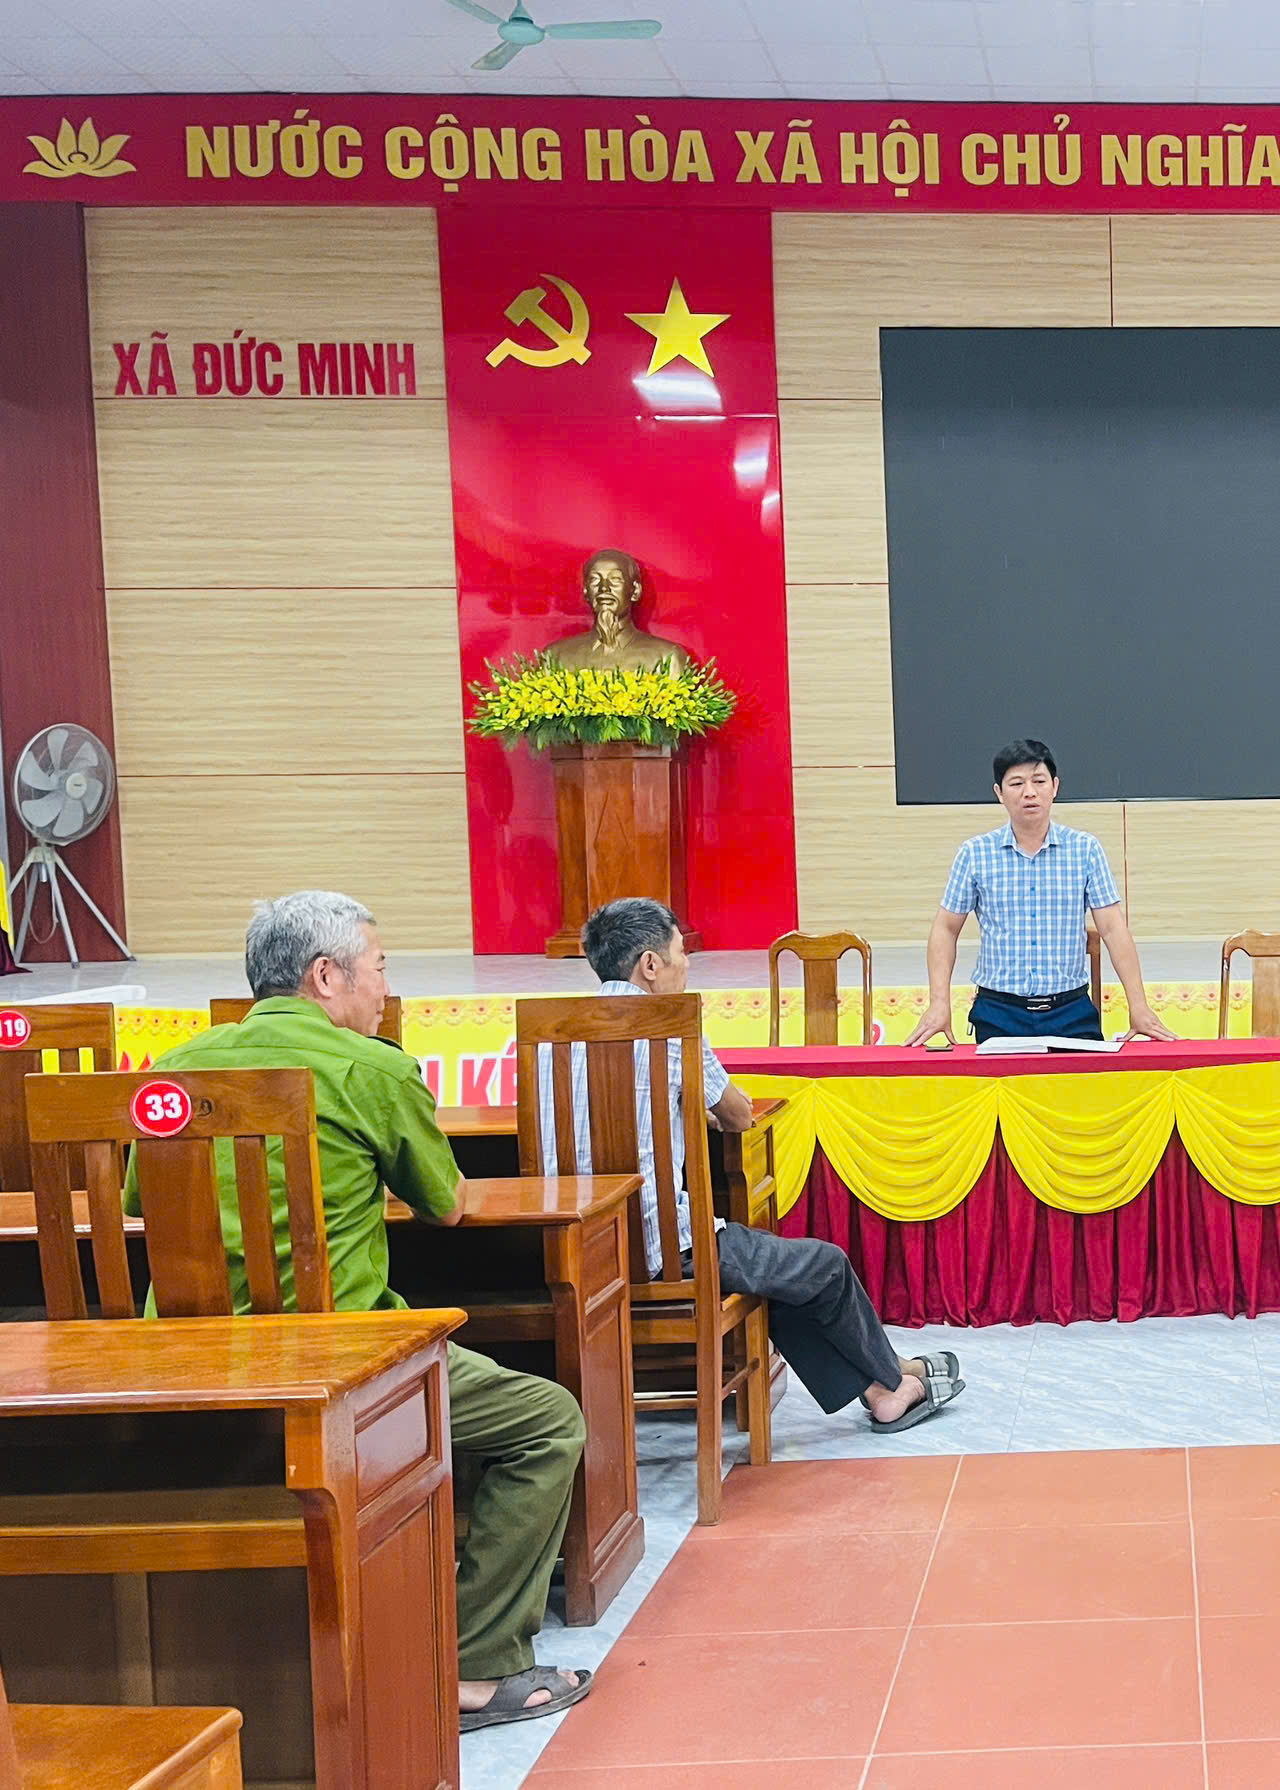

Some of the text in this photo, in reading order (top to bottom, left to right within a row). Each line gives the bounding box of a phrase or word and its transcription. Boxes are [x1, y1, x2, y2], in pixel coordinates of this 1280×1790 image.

[186, 110, 363, 178] NƯỚC
[384, 113, 562, 192] CỘNG
[585, 115, 713, 182] HÒA
[735, 119, 820, 184] XÃ
[840, 119, 939, 197] HỘI
[961, 113, 1081, 185] CHỦ
[112, 329, 416, 396] XÃ ĐỨC MINH
[0, 1018, 26, 1037] 19
[146, 1092, 182, 1121] 33
